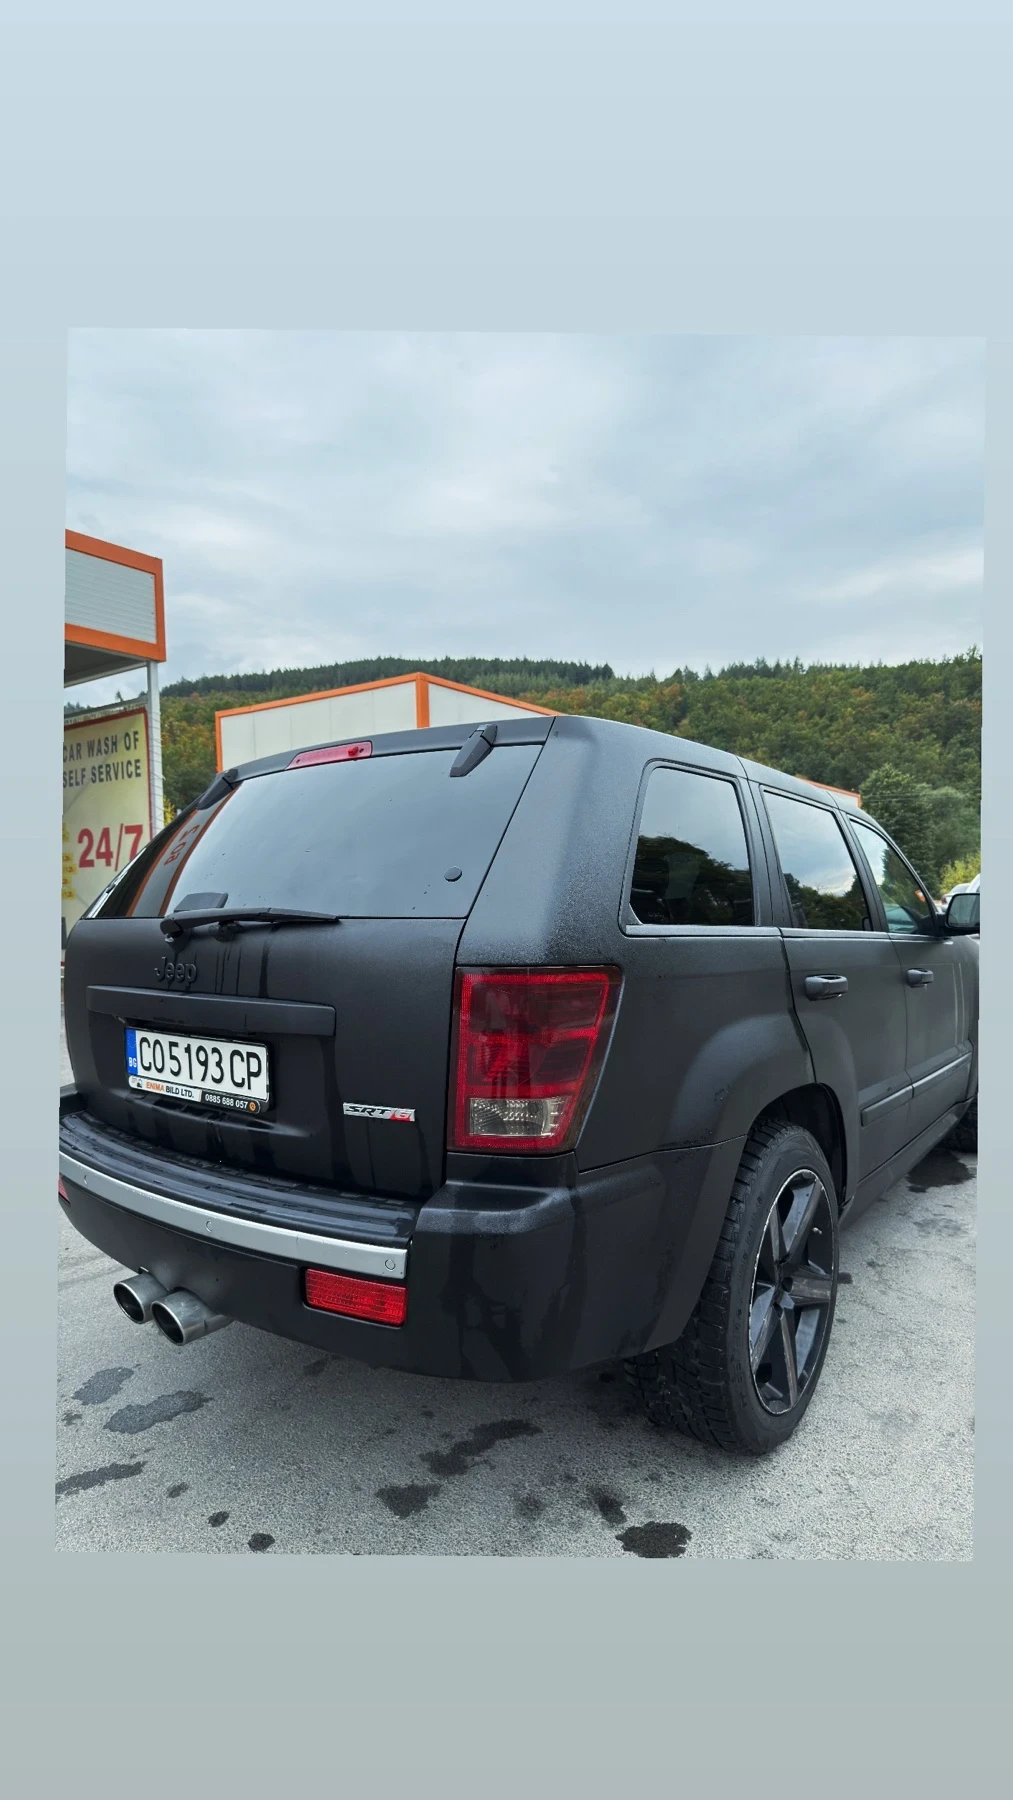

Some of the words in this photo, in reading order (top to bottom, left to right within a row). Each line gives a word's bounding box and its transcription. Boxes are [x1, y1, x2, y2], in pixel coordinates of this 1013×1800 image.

[62, 742, 82, 762] CAR
[87, 734, 118, 757] WASH
[124, 730, 139, 751] OF
[62, 768, 86, 788] SELF
[91, 759, 142, 784] SERVICE
[77, 823, 143, 872] 24/7
[153, 956, 197, 984] Jeep
[128, 1056, 137, 1068] BG
